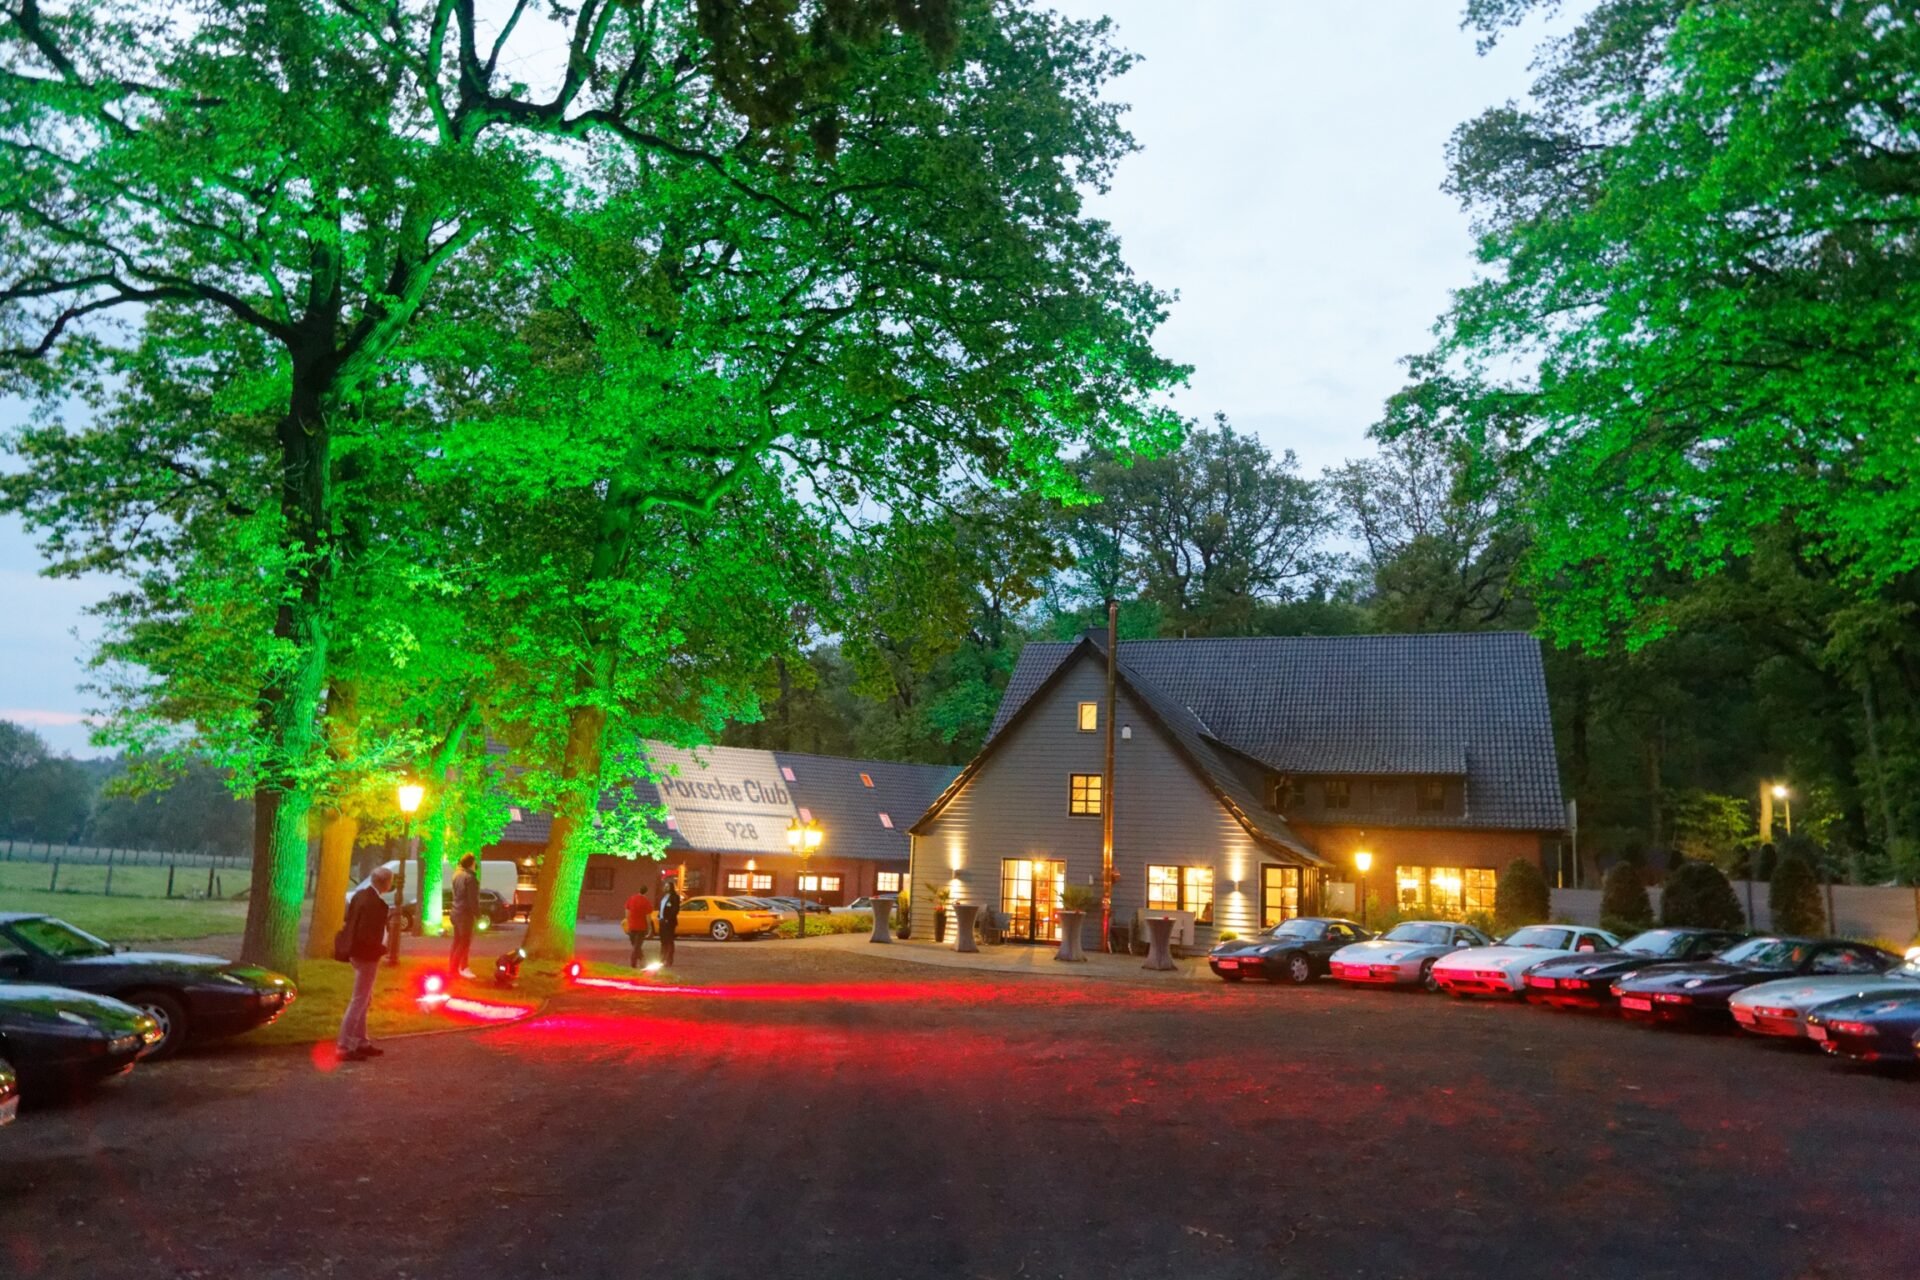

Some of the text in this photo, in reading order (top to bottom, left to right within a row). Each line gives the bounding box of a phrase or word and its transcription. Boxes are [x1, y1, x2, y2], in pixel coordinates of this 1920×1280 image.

[661, 774, 789, 804] Porsche Club
[725, 822, 758, 839] 928
